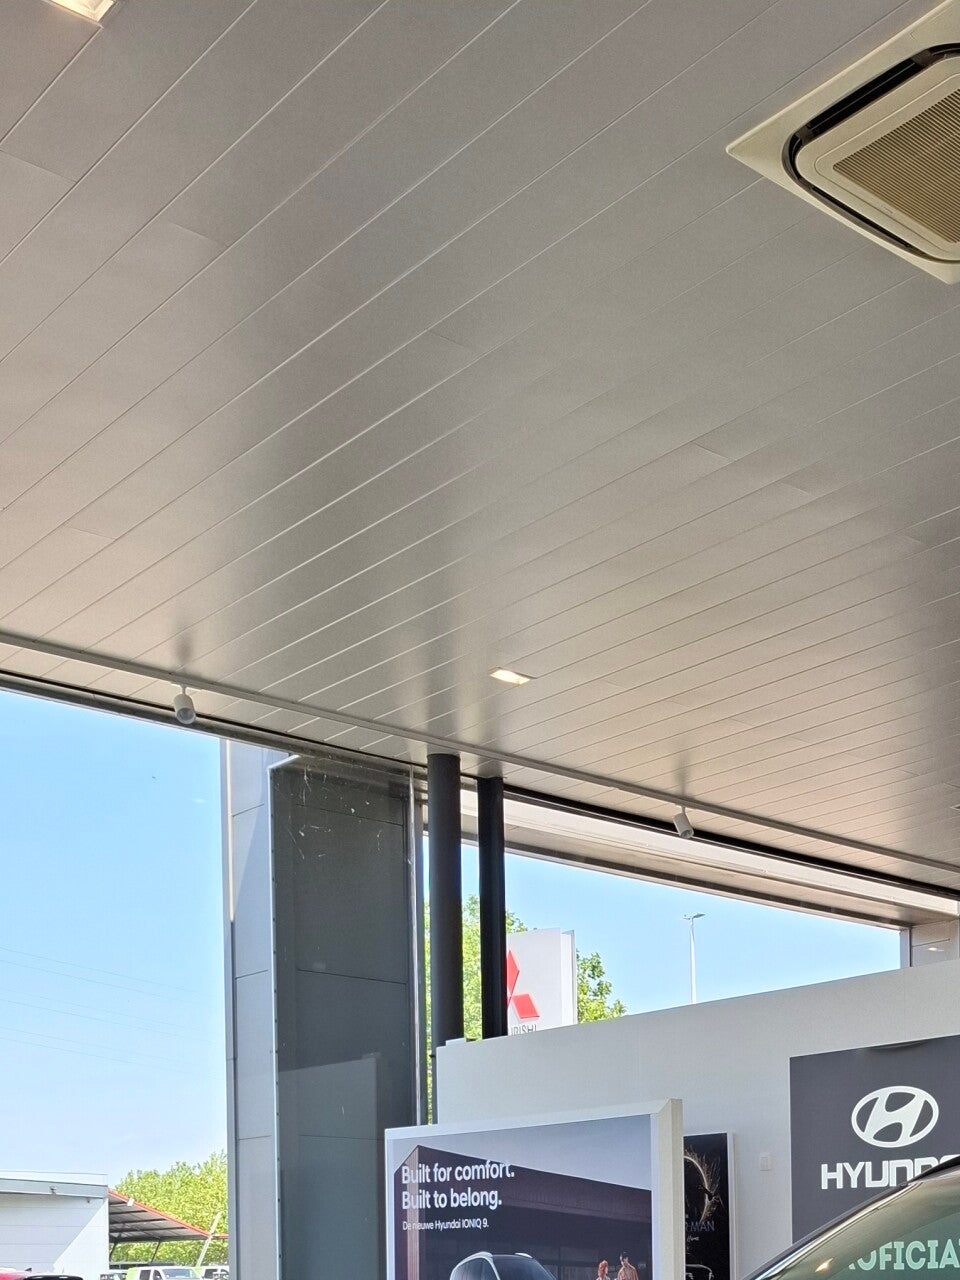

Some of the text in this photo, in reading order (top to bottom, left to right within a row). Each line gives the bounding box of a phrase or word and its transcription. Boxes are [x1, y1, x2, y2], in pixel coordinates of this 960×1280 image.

[402, 1160, 515, 1184] Built for comfort.
[402, 1187, 502, 1210] Built to belong.
[402, 1221, 411, 1231] De
[412, 1221, 434, 1230] nieuwe
[435, 1218, 461, 1231] Hyundai
[462, 1218, 482, 1229] IONIQ
